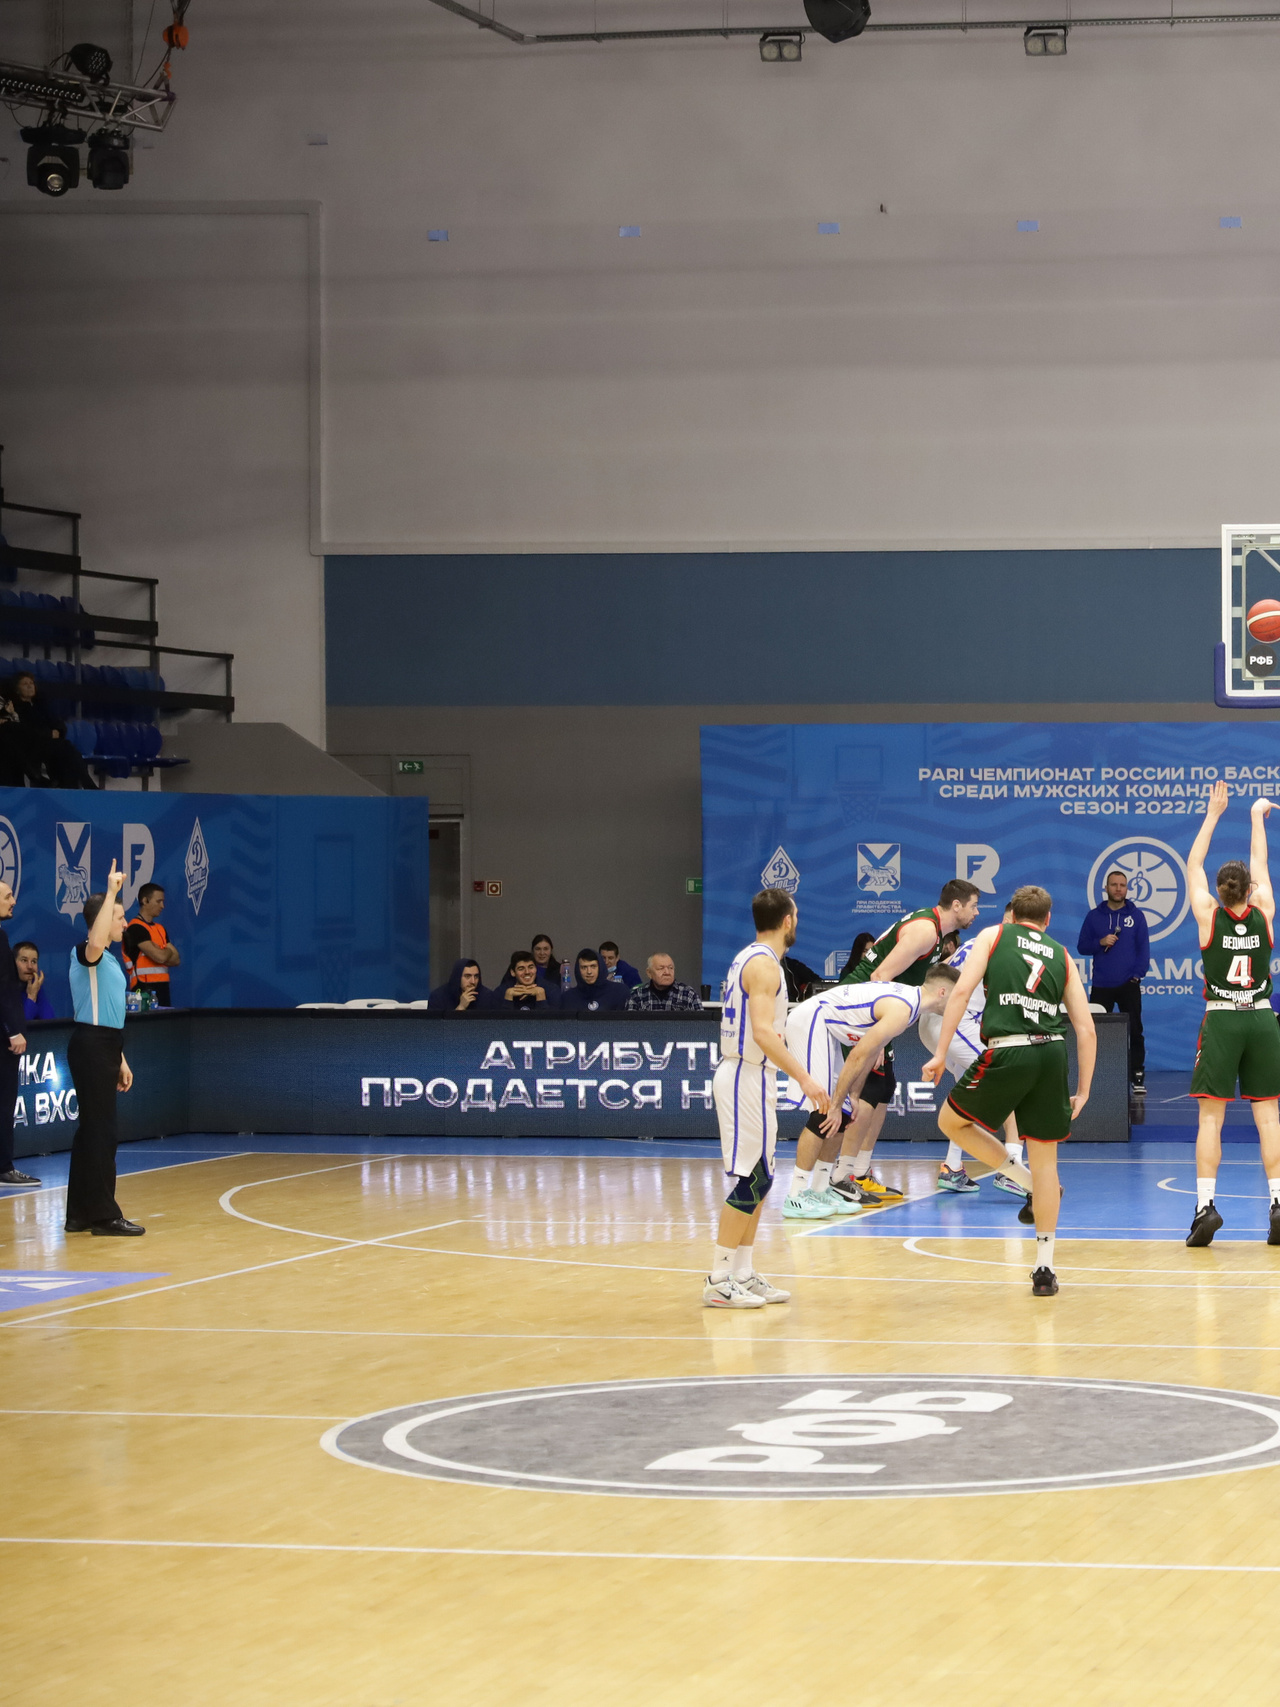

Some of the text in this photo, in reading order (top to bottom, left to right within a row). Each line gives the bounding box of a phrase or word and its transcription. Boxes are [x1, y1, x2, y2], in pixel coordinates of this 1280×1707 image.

[1249, 655, 1273, 666] РФБ
[919, 768, 963, 781] PARI
[971, 768, 1094, 781] ЧЕМПИОНАТ
[1101, 768, 1184, 781] РОССИИ
[1191, 767, 1219, 780] ПО
[940, 785, 1007, 798] СРЕДИ
[1013, 785, 1118, 798] МУЖСКИХ
[1060, 801, 1210, 814] СЕЗОН 2022/2
[1222, 935, 1260, 950] ВЕДИЩЕВ
[1022, 953, 1046, 993] 7
[1226, 954, 1255, 989] 4
[360, 1077, 662, 1112] ПРОДАЕТСЯ
